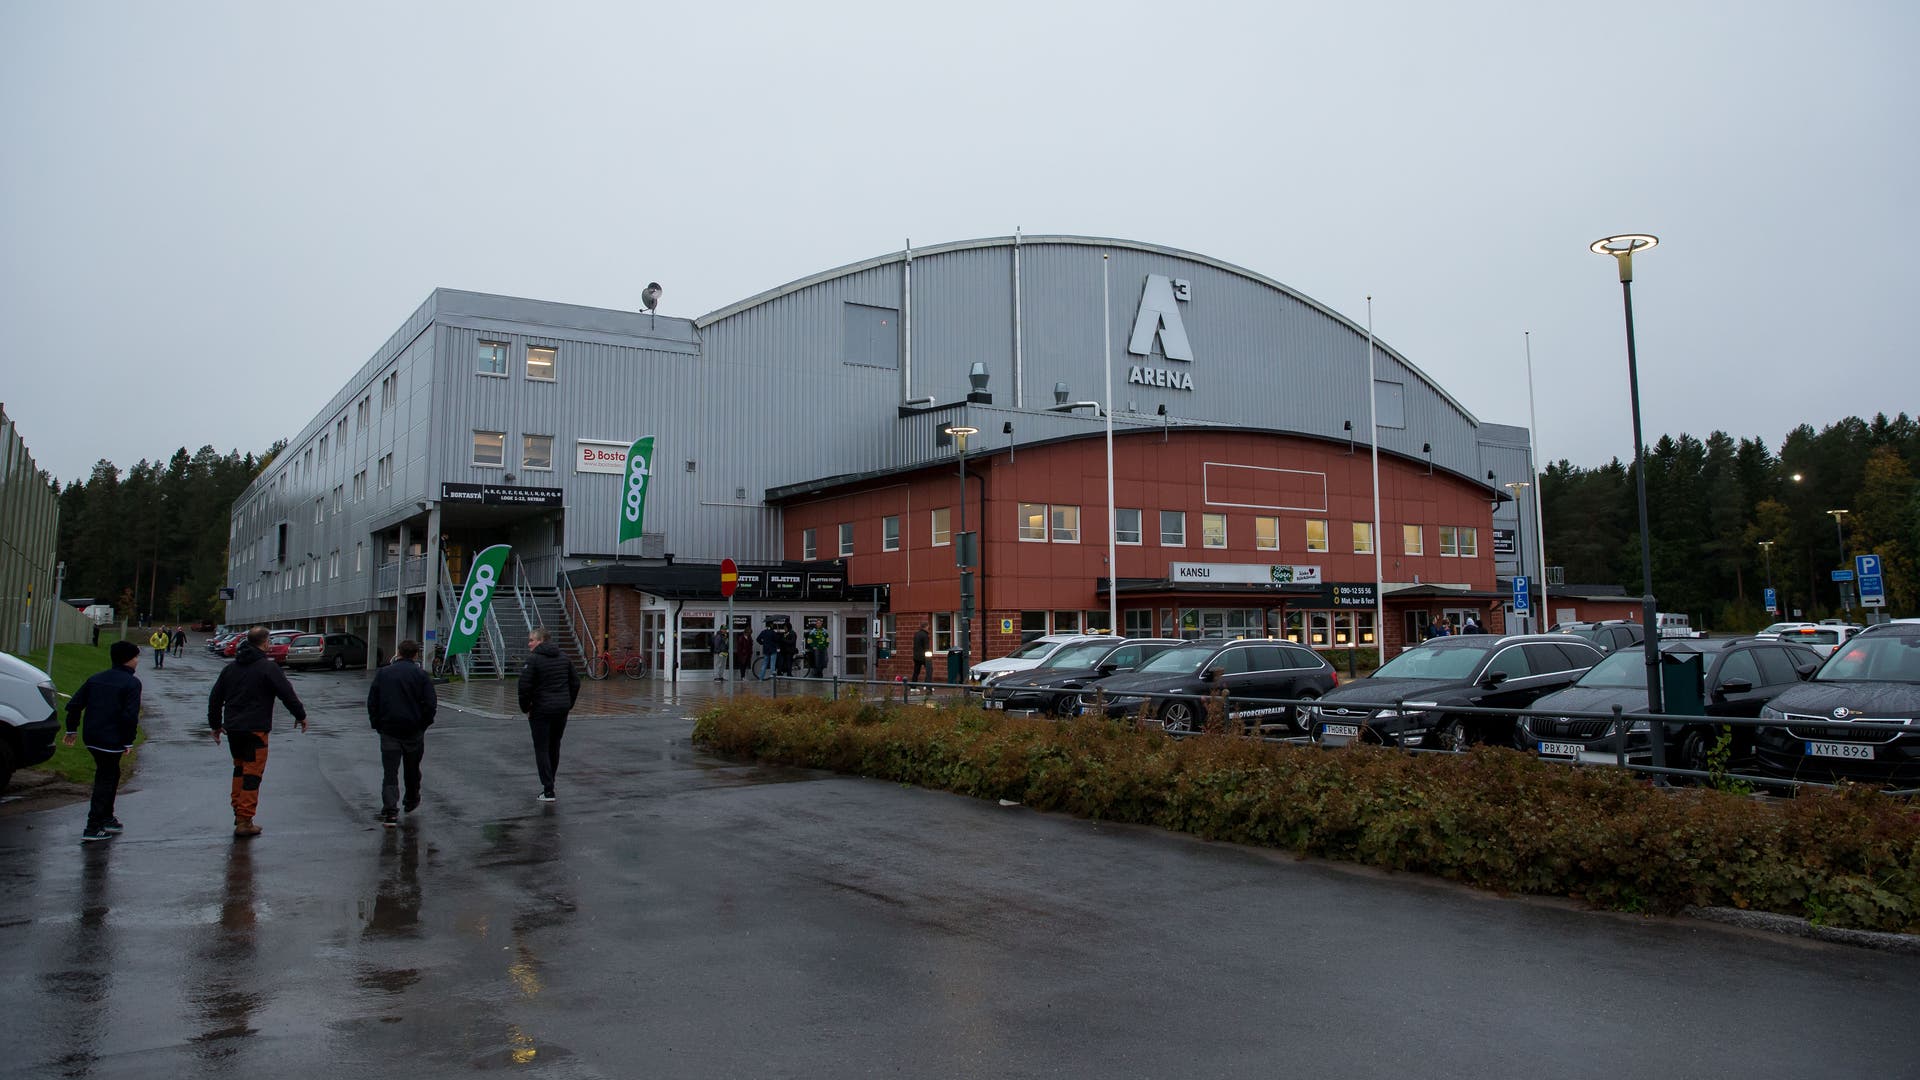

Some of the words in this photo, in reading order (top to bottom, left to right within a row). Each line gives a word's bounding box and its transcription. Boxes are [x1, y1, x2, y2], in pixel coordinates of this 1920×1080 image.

[1129, 366, 1194, 390] ARENA
[598, 450, 626, 461] Bosta
[626, 455, 648, 522] coop
[1180, 568, 1210, 577] KANSLI
[1862, 558, 1875, 574] P
[1517, 578, 1525, 591] P
[460, 564, 496, 636] coop
[1544, 744, 1560, 753] PBX
[1563, 745, 1580, 754] 200
[1816, 744, 1838, 755] XYR
[1843, 746, 1868, 757] 896
